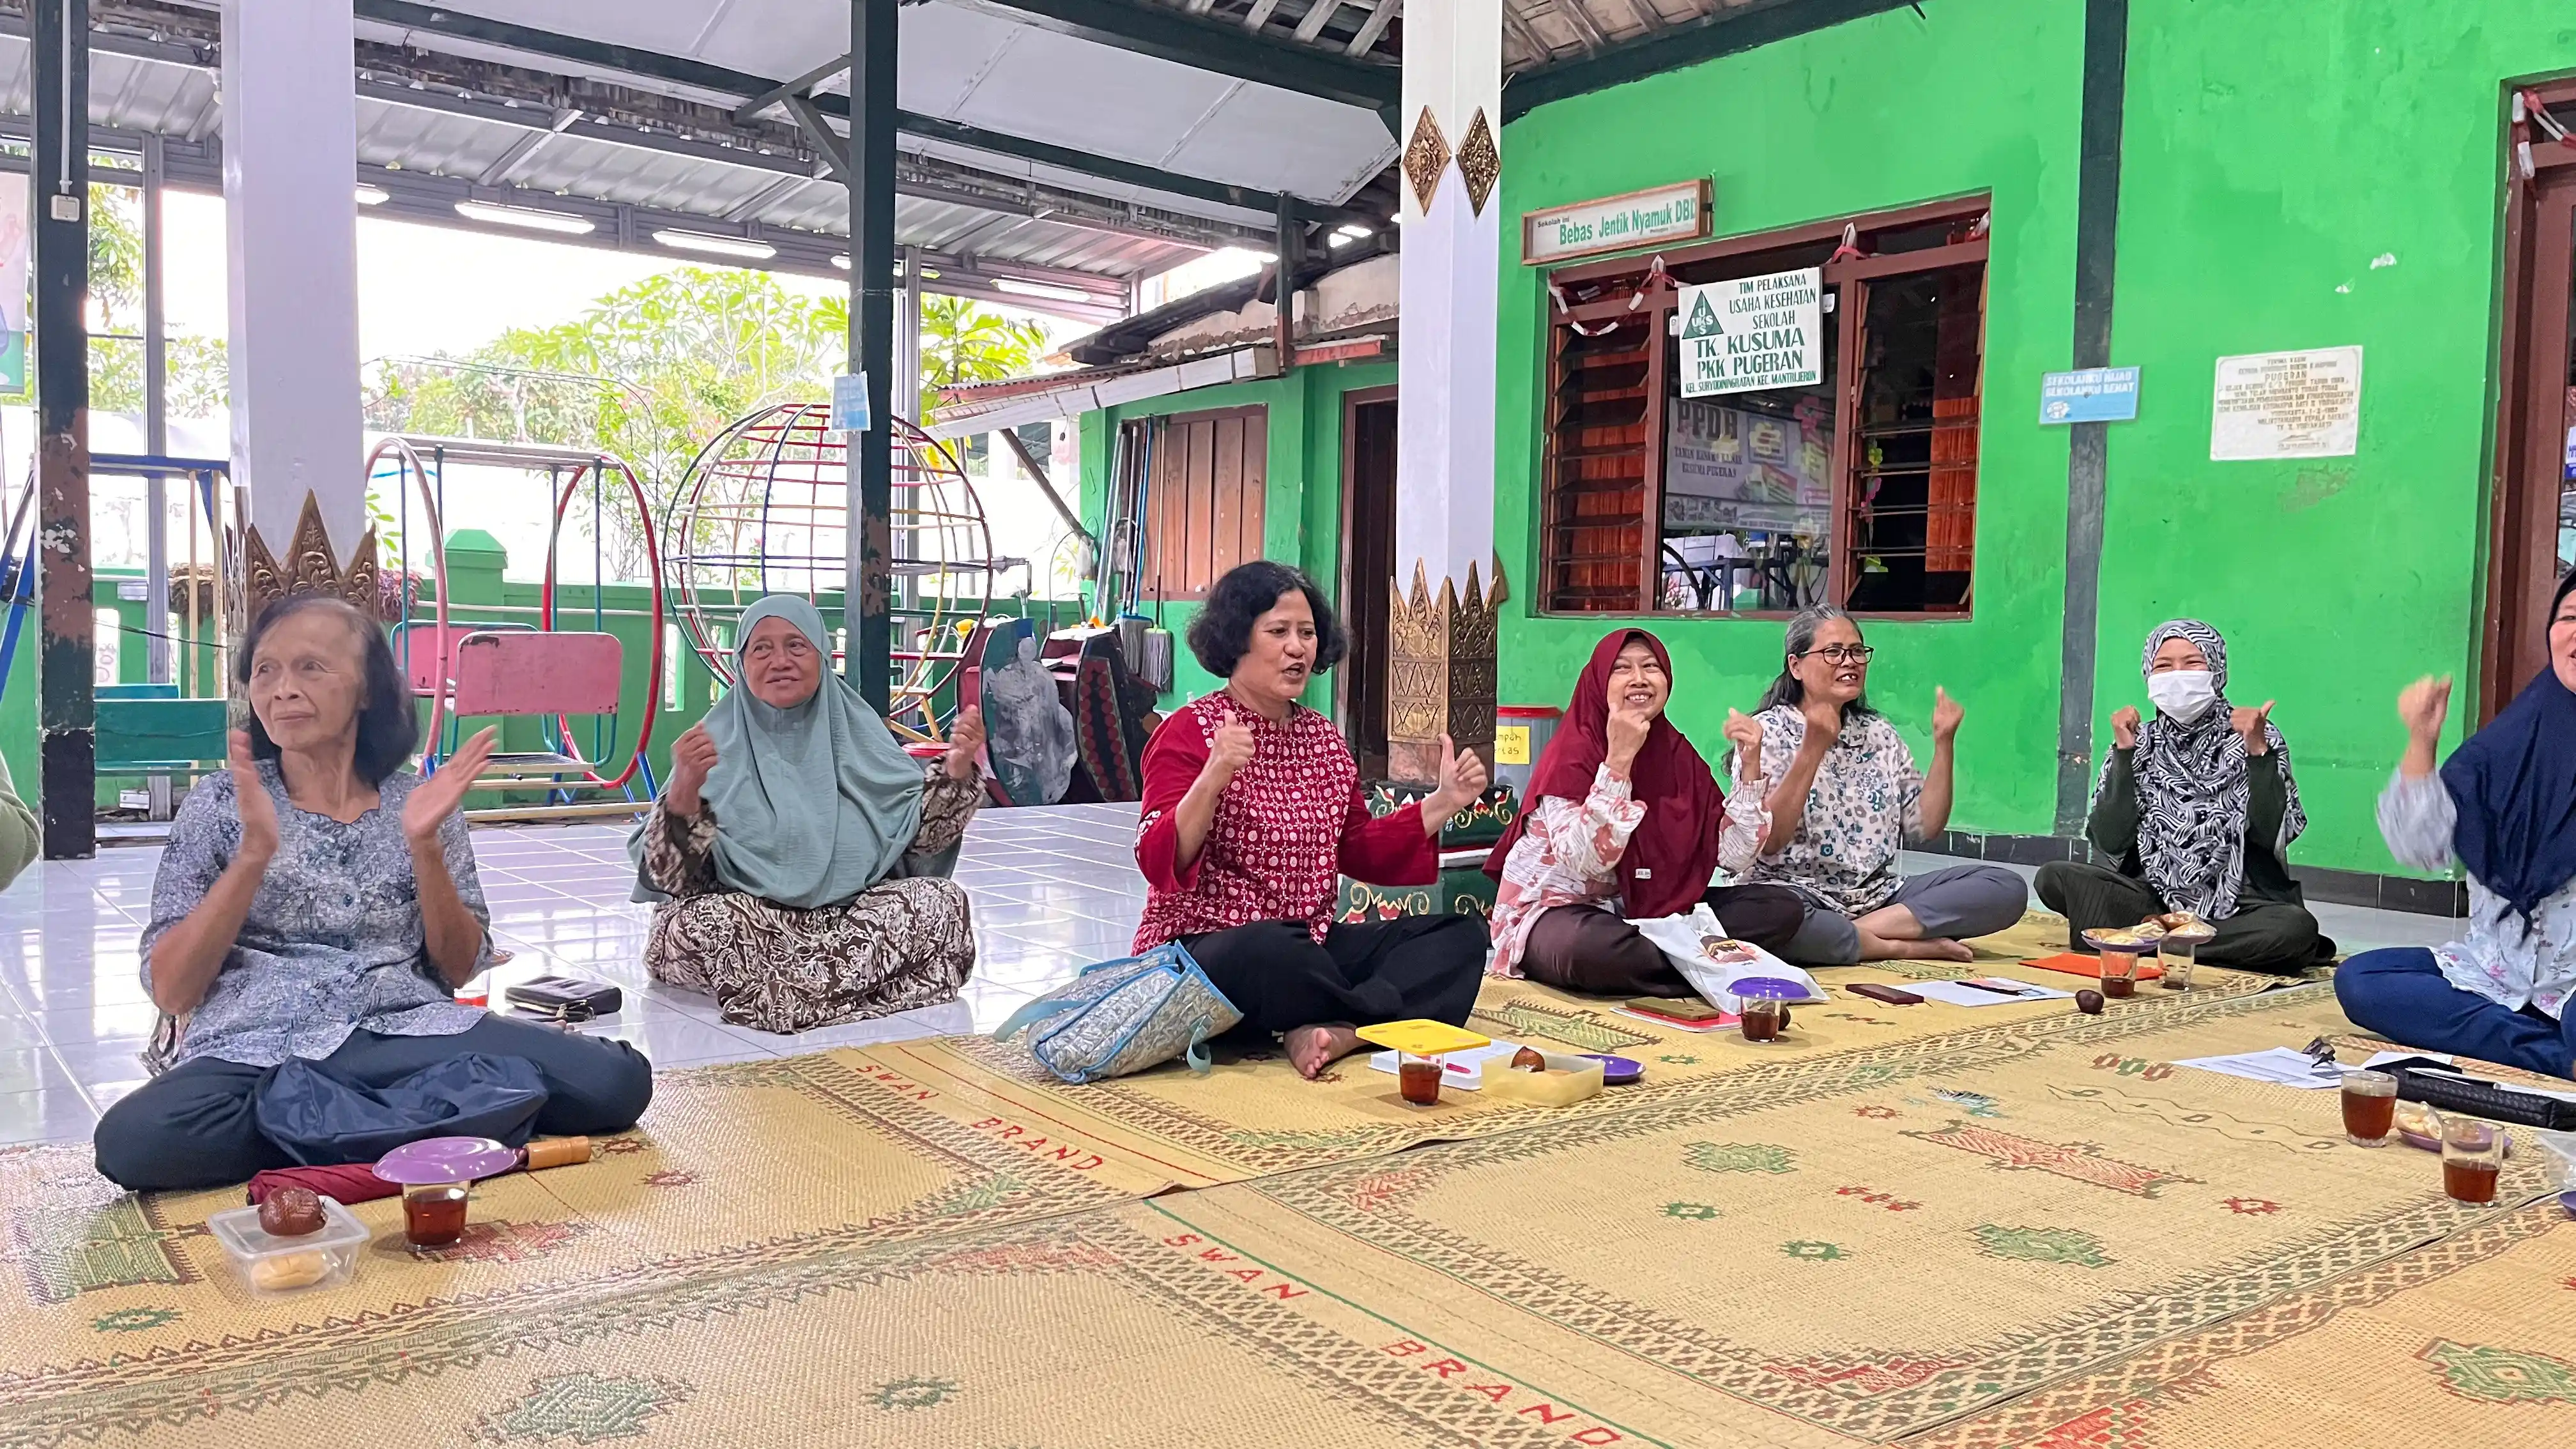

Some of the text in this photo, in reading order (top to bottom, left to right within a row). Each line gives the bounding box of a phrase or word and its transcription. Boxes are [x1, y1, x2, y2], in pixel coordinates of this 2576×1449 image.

[1537, 218, 1561, 228] Sekolah
[1560, 223, 1593, 245] Bebas
[1598, 211, 1629, 238] Jentik
[1632, 203, 1672, 235] Nyamuk
[1739, 273, 1807, 294] TIM PELAKSANA
[1729, 288, 1816, 314] USAHA KESEHATAN
[1752, 310, 1795, 330] SEKOLAH
[1694, 327, 1805, 358] TK. KUSUMA
[1697, 349, 1803, 379] PKK PUGERAN
[1771, 371, 1816, 385] MANTRIJERON
[856, 1065, 1104, 1170] SWAN BRAND
[1164, 1233, 1622, 1446] SWAN BRAND
